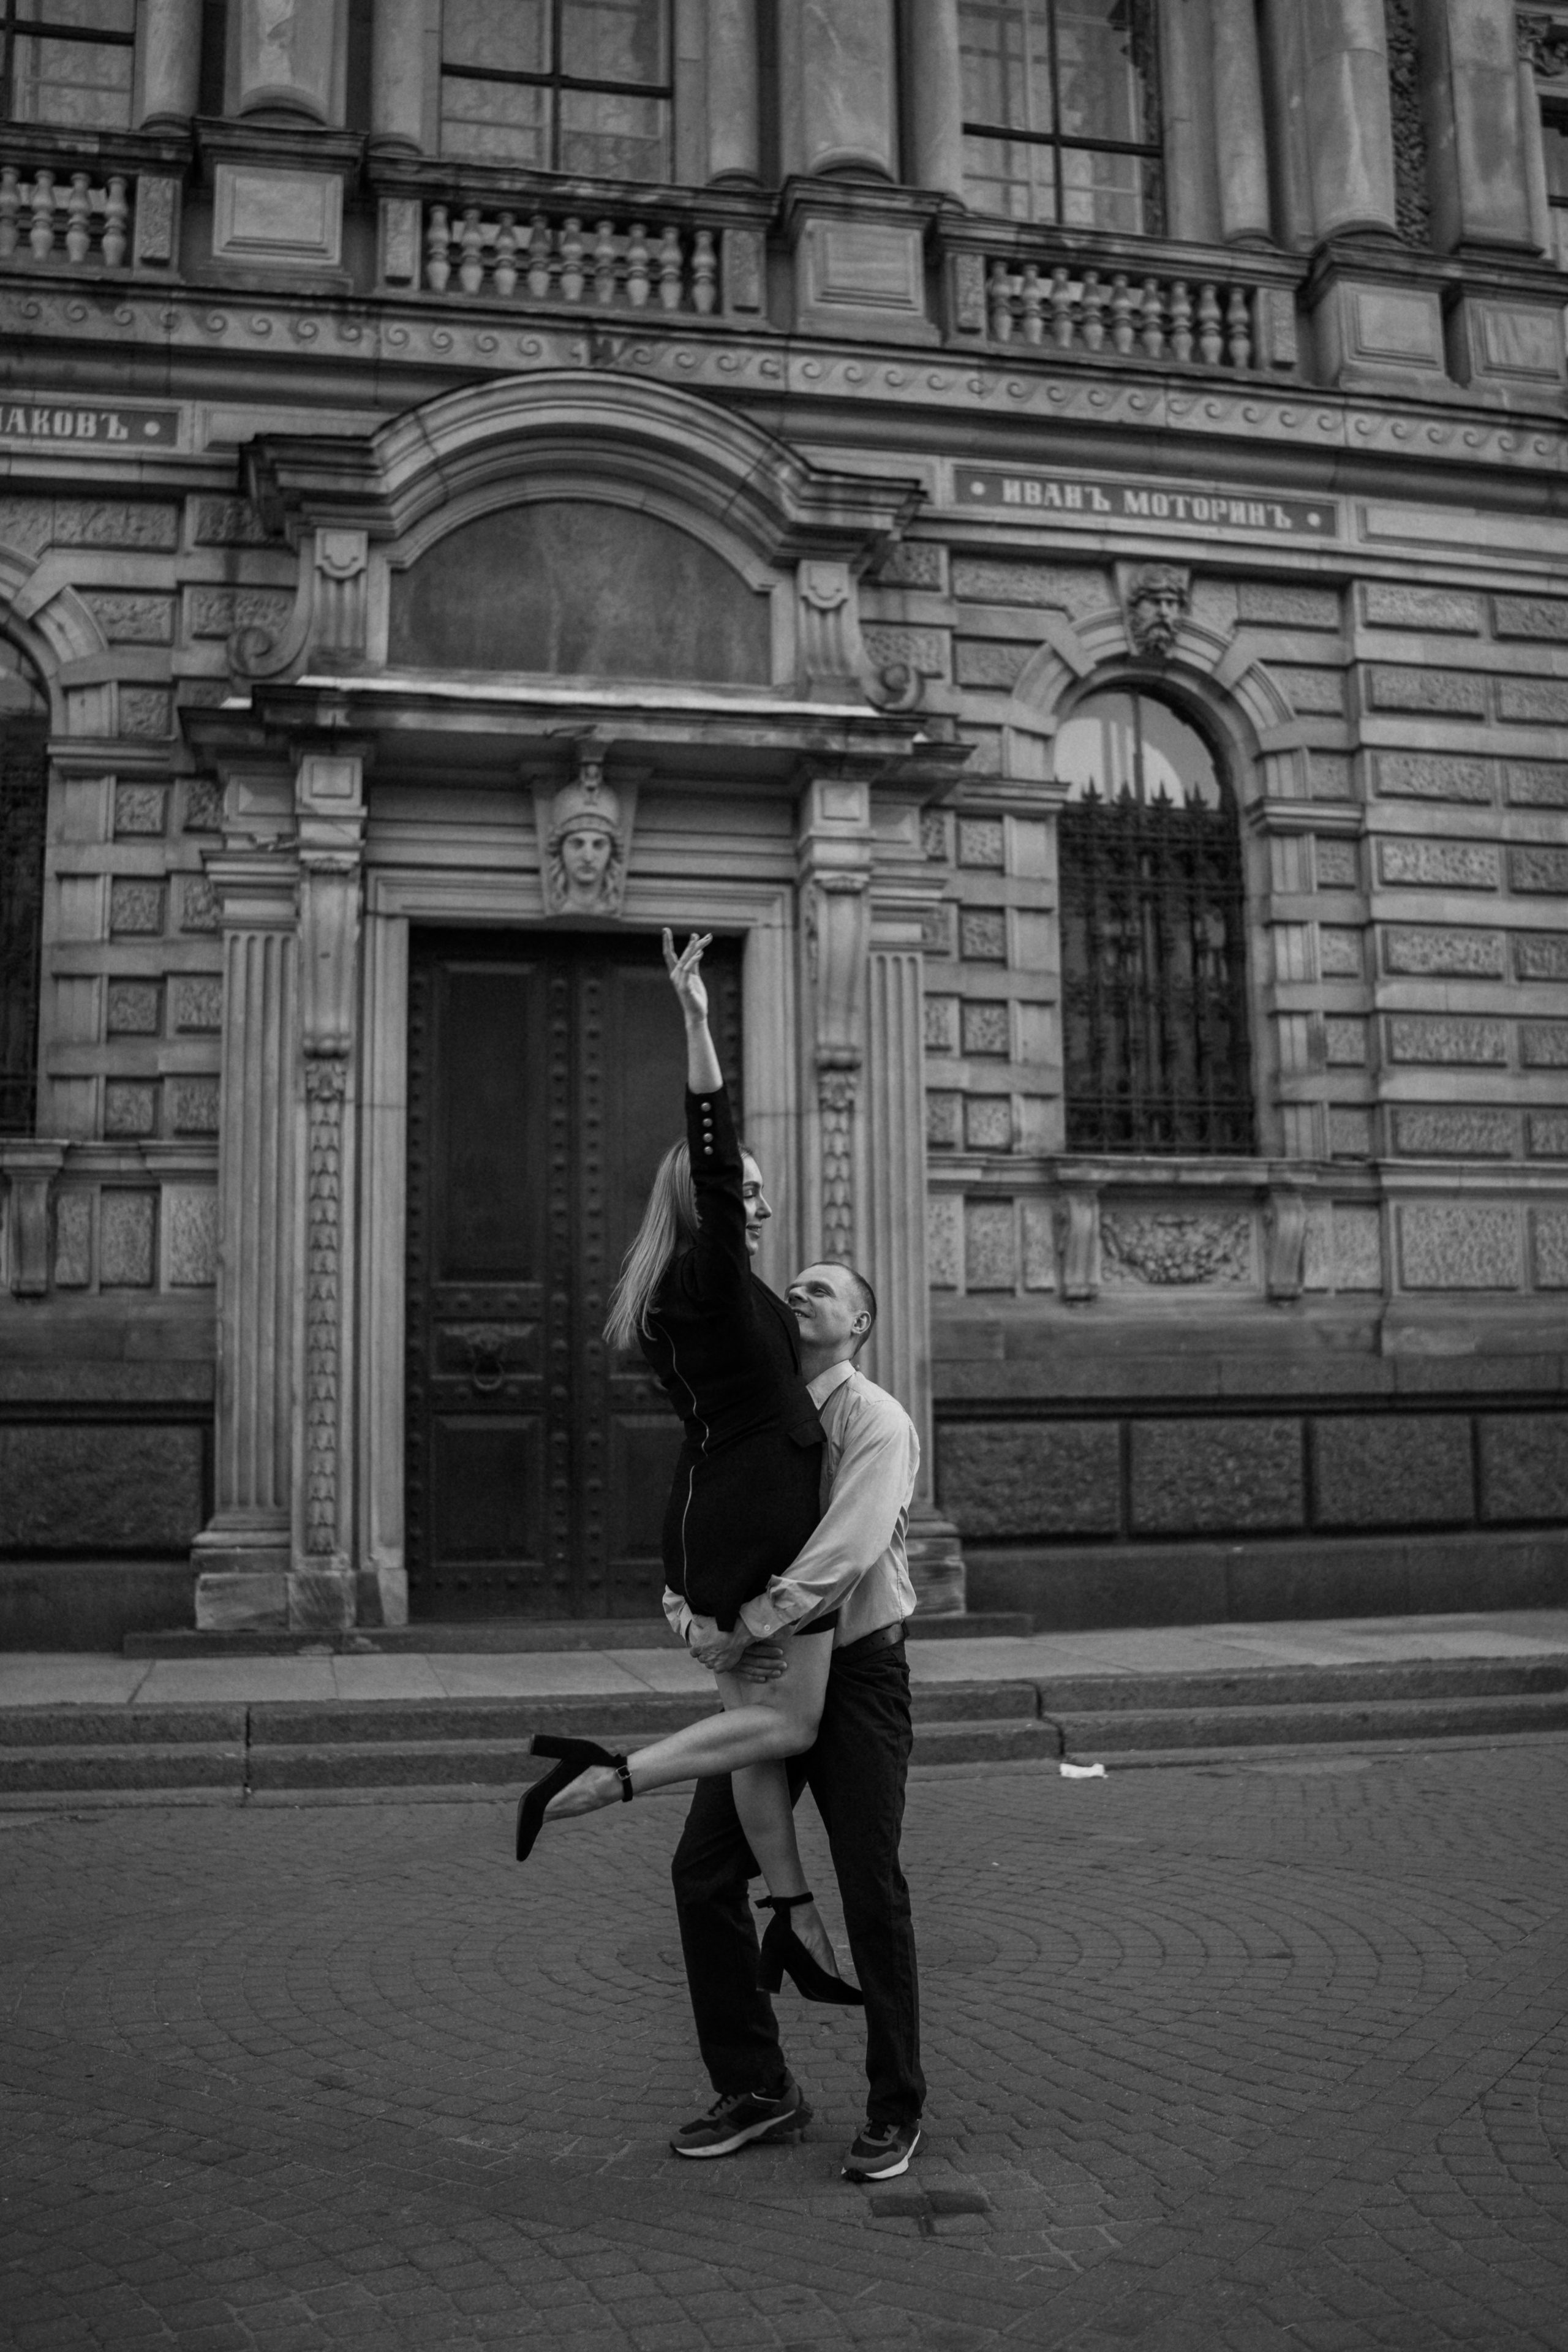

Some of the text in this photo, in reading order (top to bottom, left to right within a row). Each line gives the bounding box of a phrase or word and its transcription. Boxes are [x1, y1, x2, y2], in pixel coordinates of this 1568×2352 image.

[0, 407, 128, 440] АКОВЪ
[1003, 479, 1292, 529] ИВАНЪ МОТОРИНЪ
